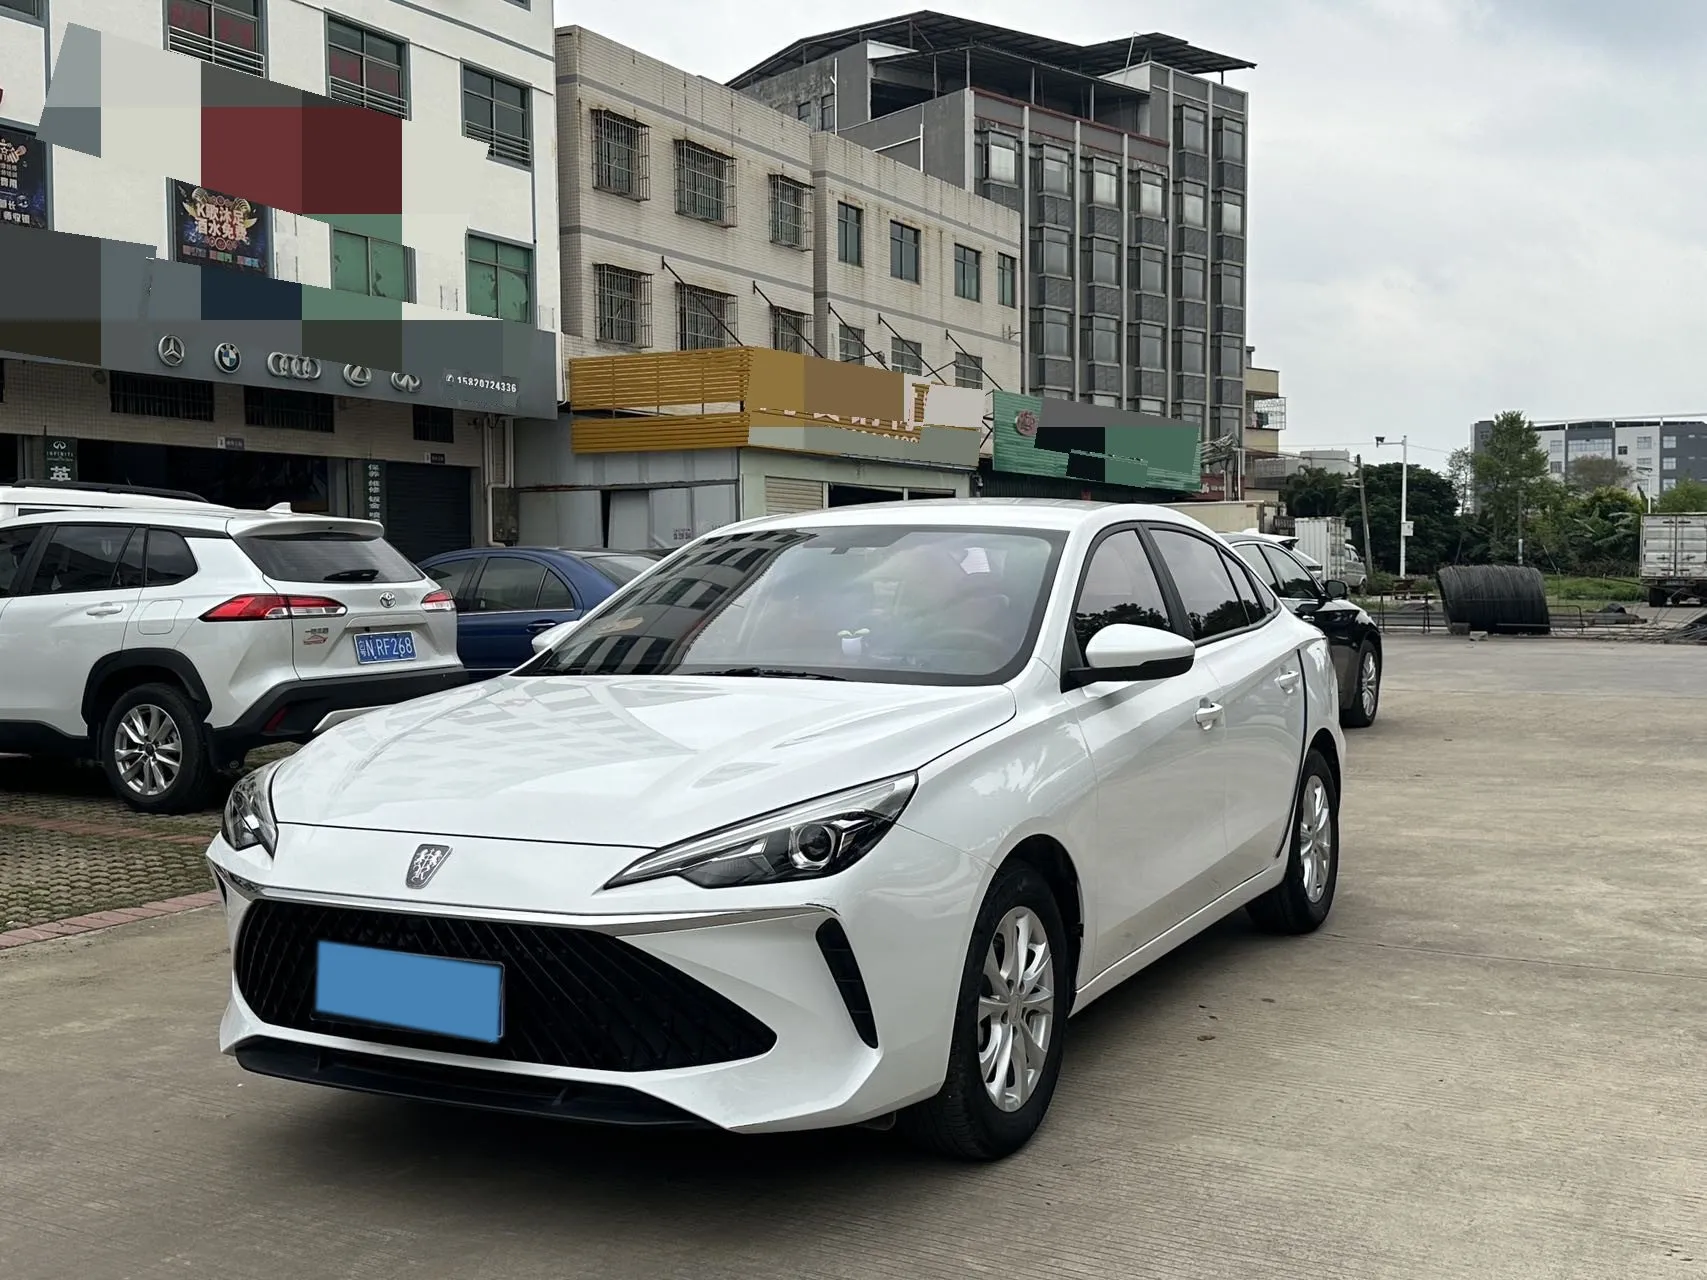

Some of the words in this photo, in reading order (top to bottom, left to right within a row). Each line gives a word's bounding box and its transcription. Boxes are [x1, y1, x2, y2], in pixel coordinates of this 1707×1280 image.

[196, 202, 245, 225] K歌沐足
[194, 216, 248, 243] 酒水免费
